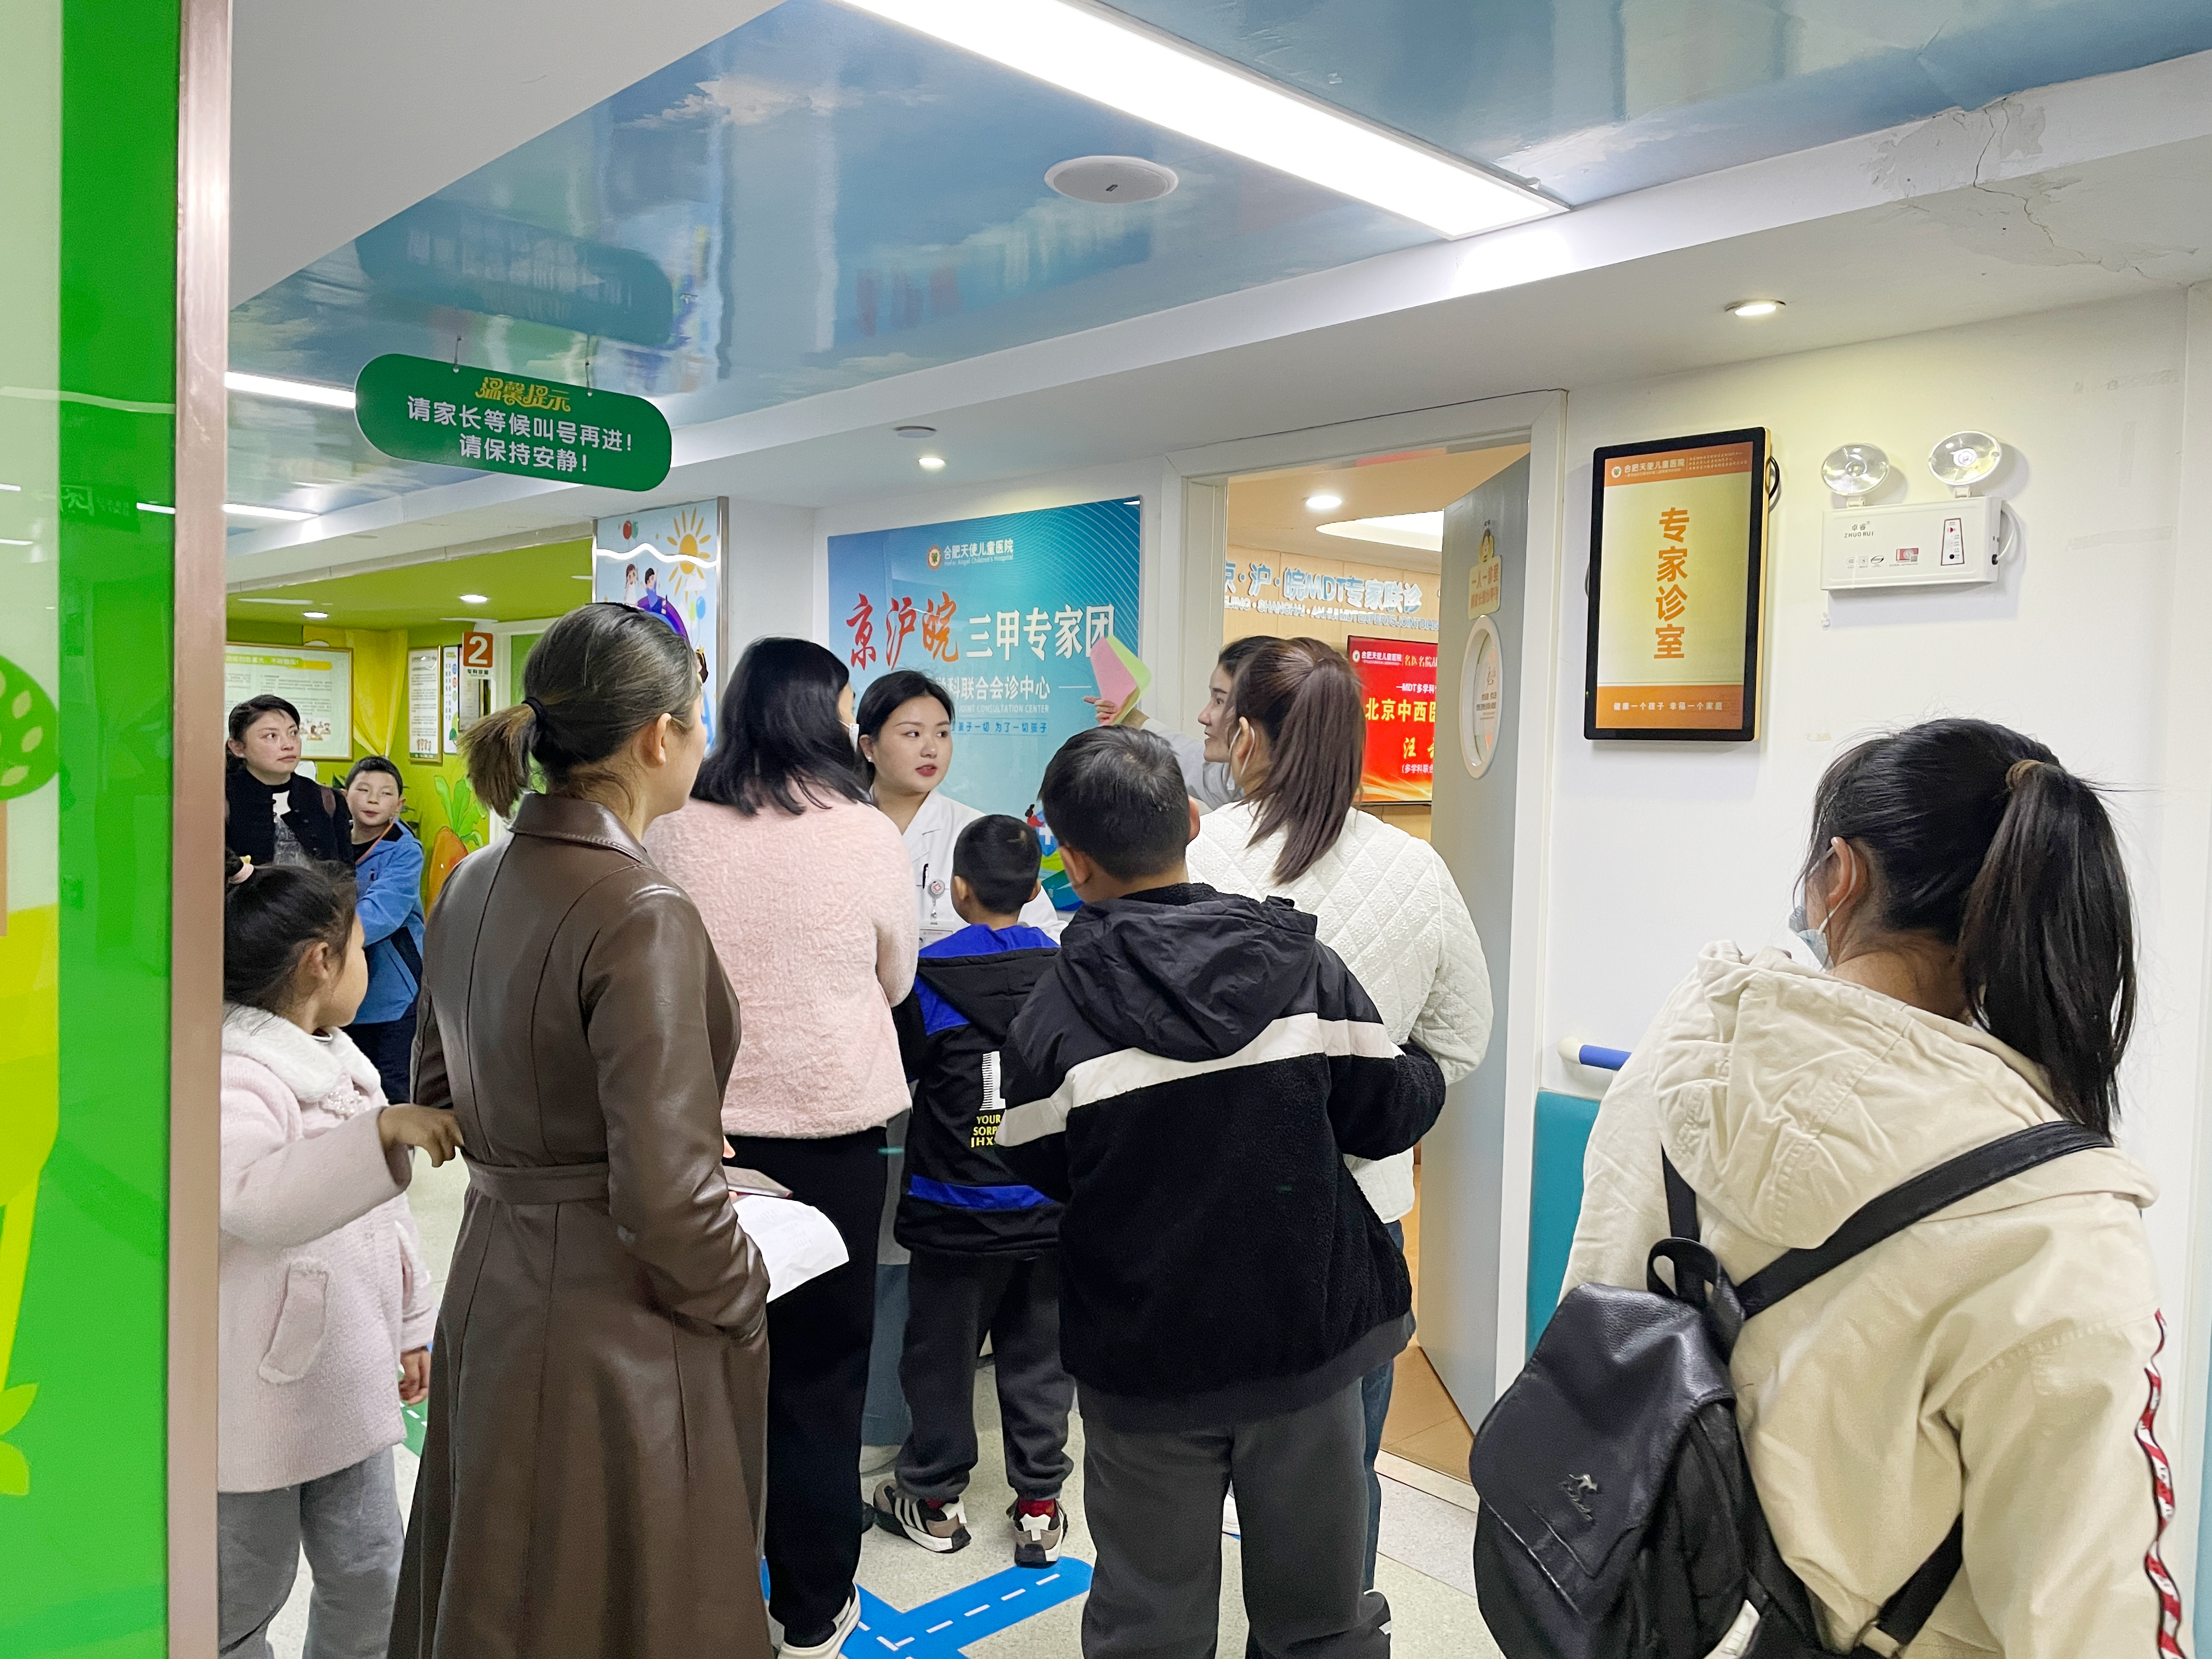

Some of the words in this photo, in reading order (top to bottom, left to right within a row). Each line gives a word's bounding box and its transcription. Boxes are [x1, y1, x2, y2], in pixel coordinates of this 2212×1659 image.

[475, 376, 571, 413] 温馨提示
[407, 396, 632, 452] 请家长等候叫号再进！
[458, 432, 587, 473] 请保持安静！
[944, 538, 1014, 560] 合肥天使儿童医院
[1654, 507, 1690, 659] 专家诊室
[845, 591, 960, 671] 京沪皖
[966, 603, 1115, 662] 三甲专家团
[468, 636, 488, 664] 2
[977, 704, 1023, 713] CONSULTATION
[1025, 704, 1049, 713] CENTER
[995, 721, 1047, 733] 为了一切孩子
[973, 1126, 998, 1136] SORP
[976, 1114, 1001, 1125] YOUR
